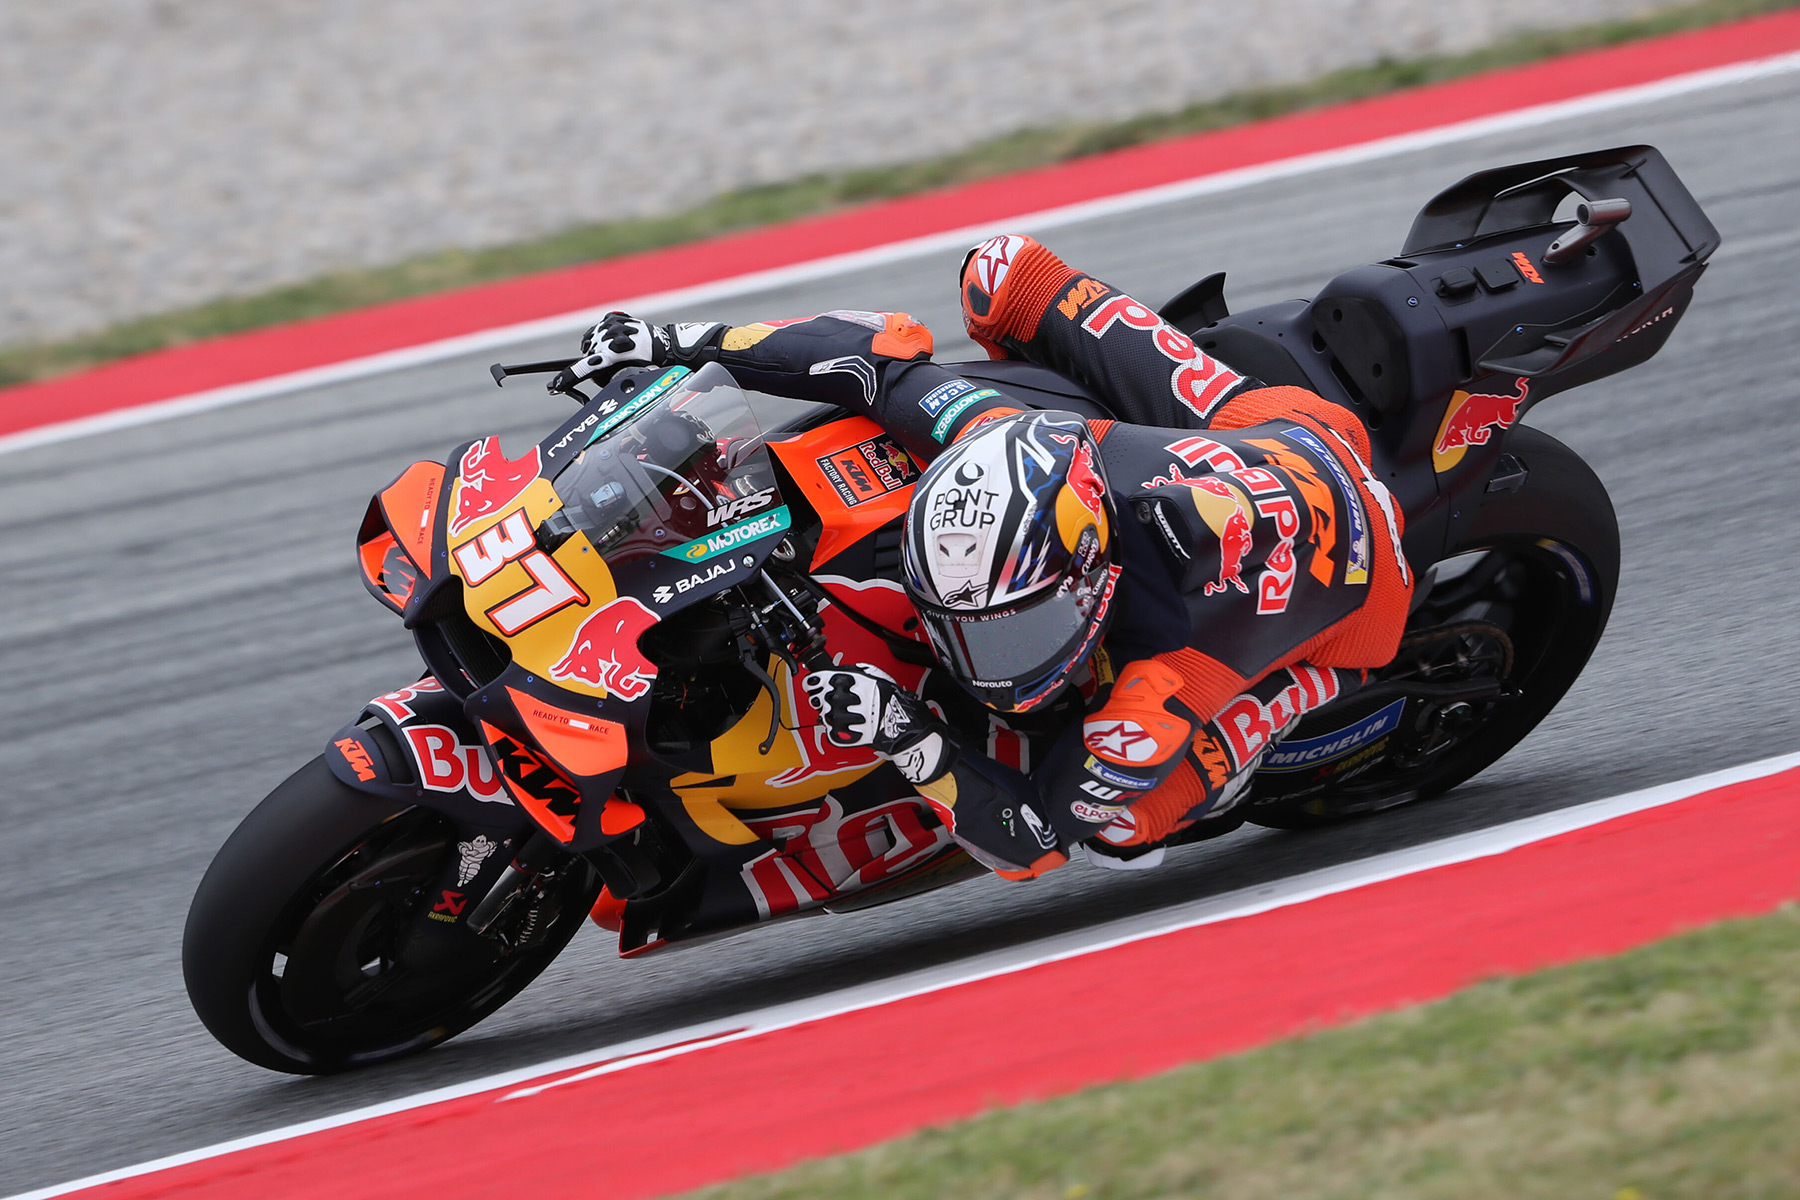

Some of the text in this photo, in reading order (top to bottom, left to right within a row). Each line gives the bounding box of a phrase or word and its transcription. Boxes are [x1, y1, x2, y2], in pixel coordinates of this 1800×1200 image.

[1511, 252, 1544, 284] KTM
[1056, 278, 1111, 320] KTM
[1080, 294, 1246, 420] Red
[599, 385, 664, 430] MOTOREX
[928, 384, 969, 410] UCAM
[935, 393, 981, 438] MOTOREX
[547, 413, 599, 458] BAJAJ
[820, 458, 858, 506] FACTORY RACING
[840, 460, 873, 492] KTM
[1163, 436, 1287, 495] Bull
[1300, 436, 1363, 532] MICHELIN
[426, 477, 436, 500] READY
[707, 487, 775, 528] WRS
[707, 513, 781, 552] MOTOREX
[930, 510, 996, 531] GRUP
[452, 506, 590, 638] 37
[675, 558, 736, 594] BAJAJ
[1256, 495, 1300, 615] Red
[955, 615, 975, 623] YOU
[980, 608, 1017, 622] WINGS
[972, 680, 1013, 689] Norauto
[533, 710, 609, 735] READY TO RACE
[1268, 715, 1389, 764] MICHELIN
[334, 737, 376, 782] KTM
[401, 724, 516, 806] Bu
[1103, 772, 1150, 787] MICHELIN
